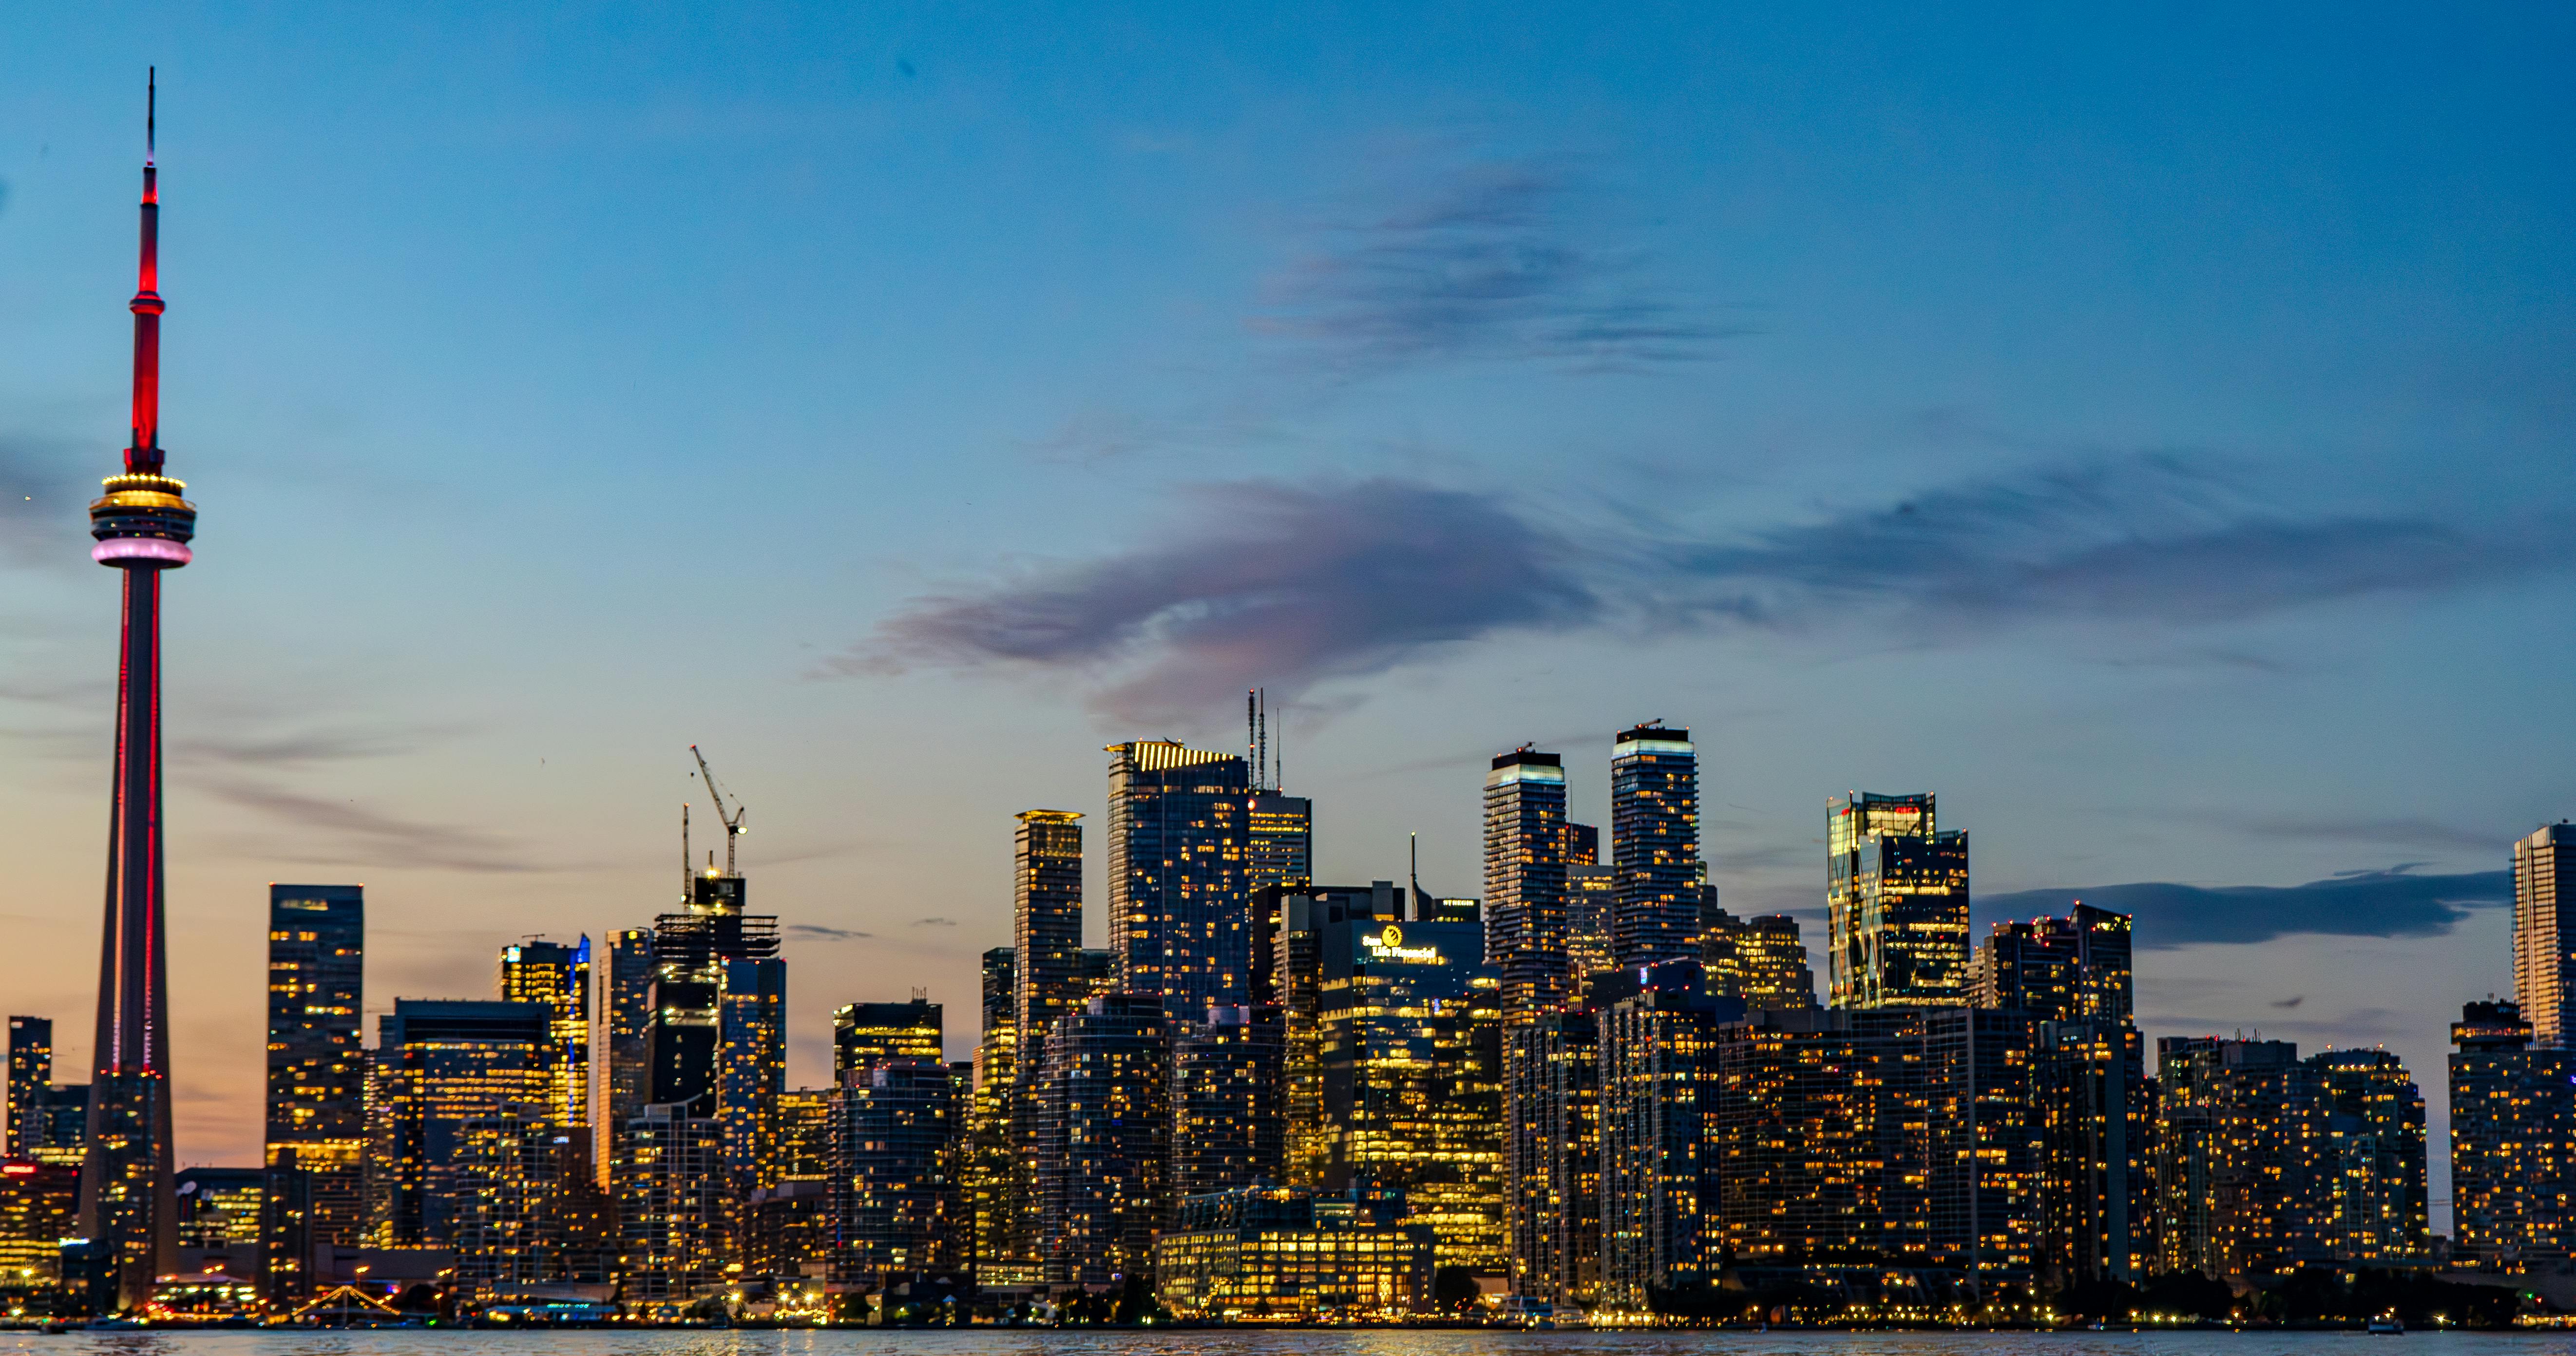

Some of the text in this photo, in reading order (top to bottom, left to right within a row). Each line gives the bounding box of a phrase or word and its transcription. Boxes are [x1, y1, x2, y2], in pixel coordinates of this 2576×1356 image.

[1362, 935, 1383, 946] Sun
[1372, 946, 1436, 958] Life Financial
